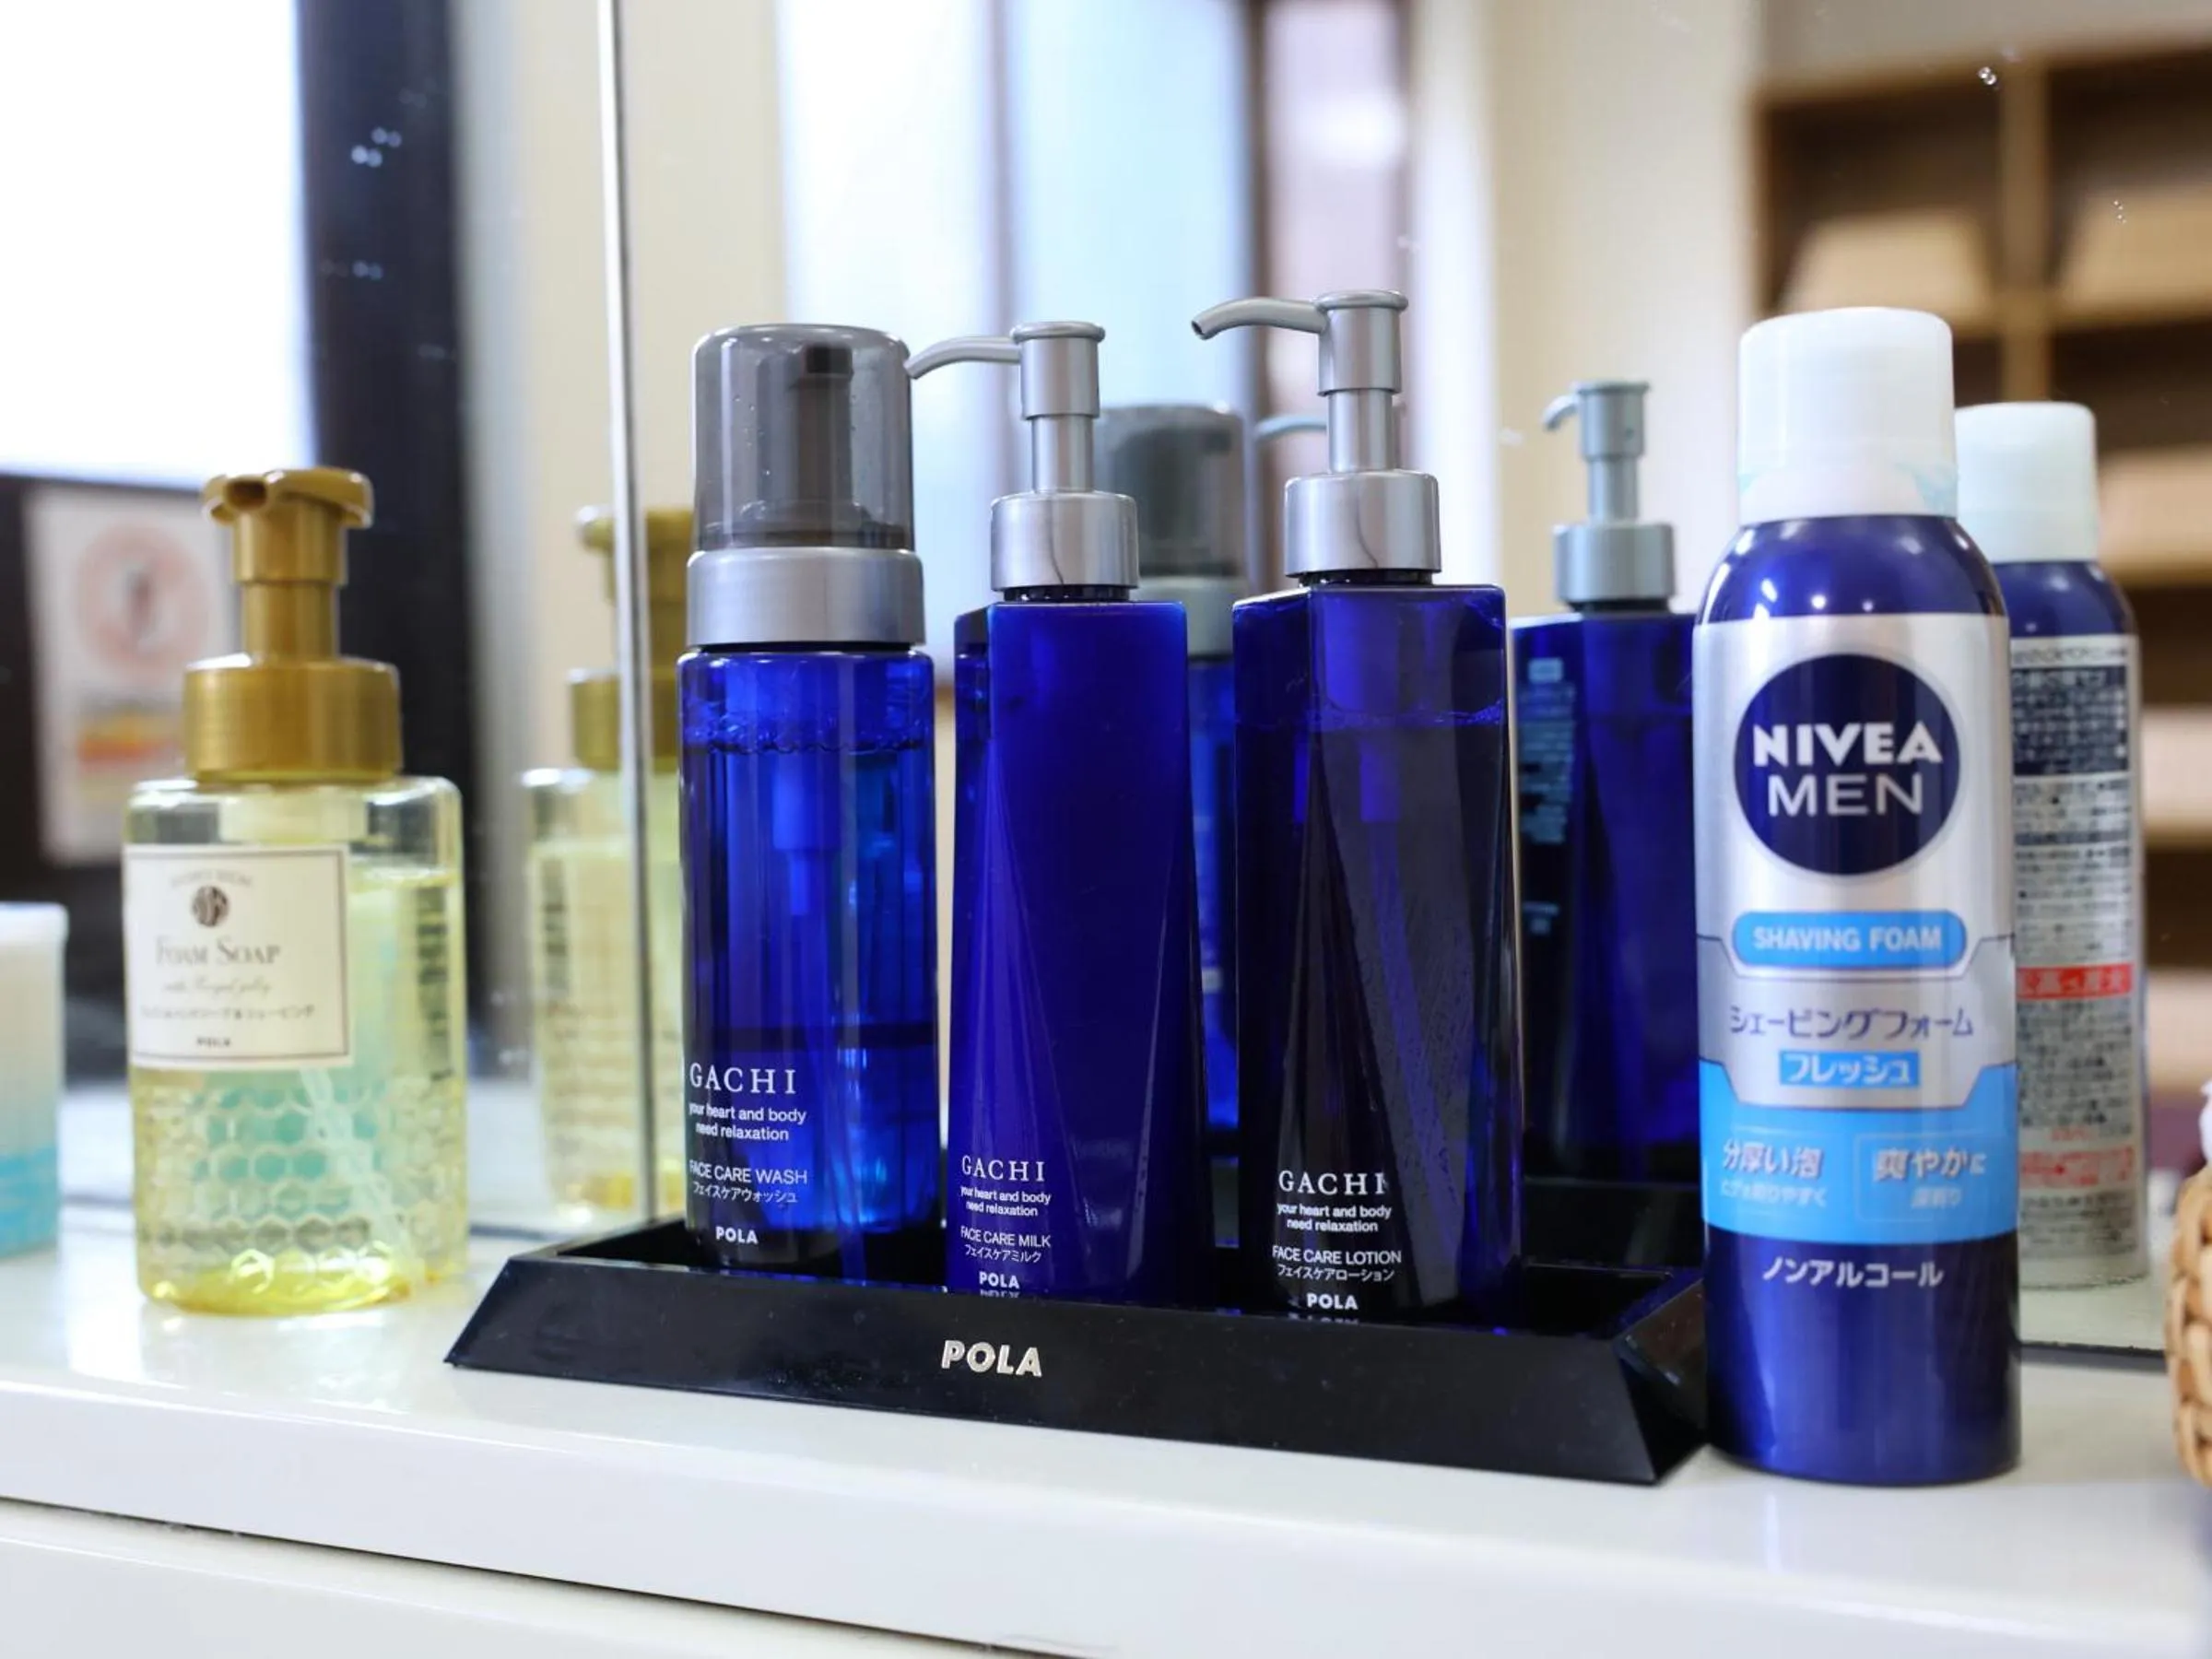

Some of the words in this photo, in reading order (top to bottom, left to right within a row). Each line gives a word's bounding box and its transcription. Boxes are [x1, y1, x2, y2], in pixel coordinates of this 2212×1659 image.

[1752, 721, 1943, 768] NIVEA
[1767, 772, 1924, 818] MEN
[1753, 926, 1861, 952] SHAVING
[1869, 924, 1943, 952] FOAM
[216, 935, 281, 966] SOAP
[1730, 1005, 1974, 1041] シェービングフォーム
[688, 1062, 797, 1095] GACHI
[1784, 1053, 1911, 1084] フレッシュ
[706, 1103, 735, 1119] heart
[738, 1107, 764, 1122] and
[769, 1108, 807, 1125] body
[695, 1122, 718, 1135] need
[720, 1124, 790, 1141] relaxation
[961, 1155, 1045, 1182] GACHI
[1723, 1139, 1825, 1180] 分厚い泡
[688, 1159, 712, 1180] FACE
[714, 1165, 752, 1183] CARE
[756, 1169, 808, 1185] WASH
[1278, 1170, 1387, 1195] GACHI
[693, 1182, 798, 1204] フェイスケアウォッシュ
[974, 1186, 998, 1201] heart
[999, 1191, 1018, 1203] and
[1021, 1191, 1052, 1206] body
[965, 1200, 983, 1213] need
[985, 1203, 1039, 1217] relaxation
[1276, 1202, 1299, 1216] your
[1299, 1203, 1330, 1218] heart
[1333, 1206, 1357, 1218] and
[1359, 1205, 1393, 1219] body
[715, 1226, 759, 1244] POLA
[960, 1225, 982, 1242] FACE
[982, 1230, 1015, 1246] CARE
[1018, 1234, 1052, 1248] MILK
[1287, 1218, 1312, 1231] need
[1315, 1218, 1379, 1233] relaxation
[964, 1244, 1042, 1264] フェイスケアミルク
[1272, 1245, 1302, 1262] FACE
[1302, 1249, 1342, 1265] CARE
[1345, 1250, 1403, 1265] LOTION
[978, 1271, 1020, 1289] POLA
[1277, 1264, 1395, 1282] フェイスケアローション
[1762, 1256, 1946, 1289] ノンアルコール
[1306, 1292, 1359, 1311] POLA
[941, 1339, 1042, 1377] POLA
